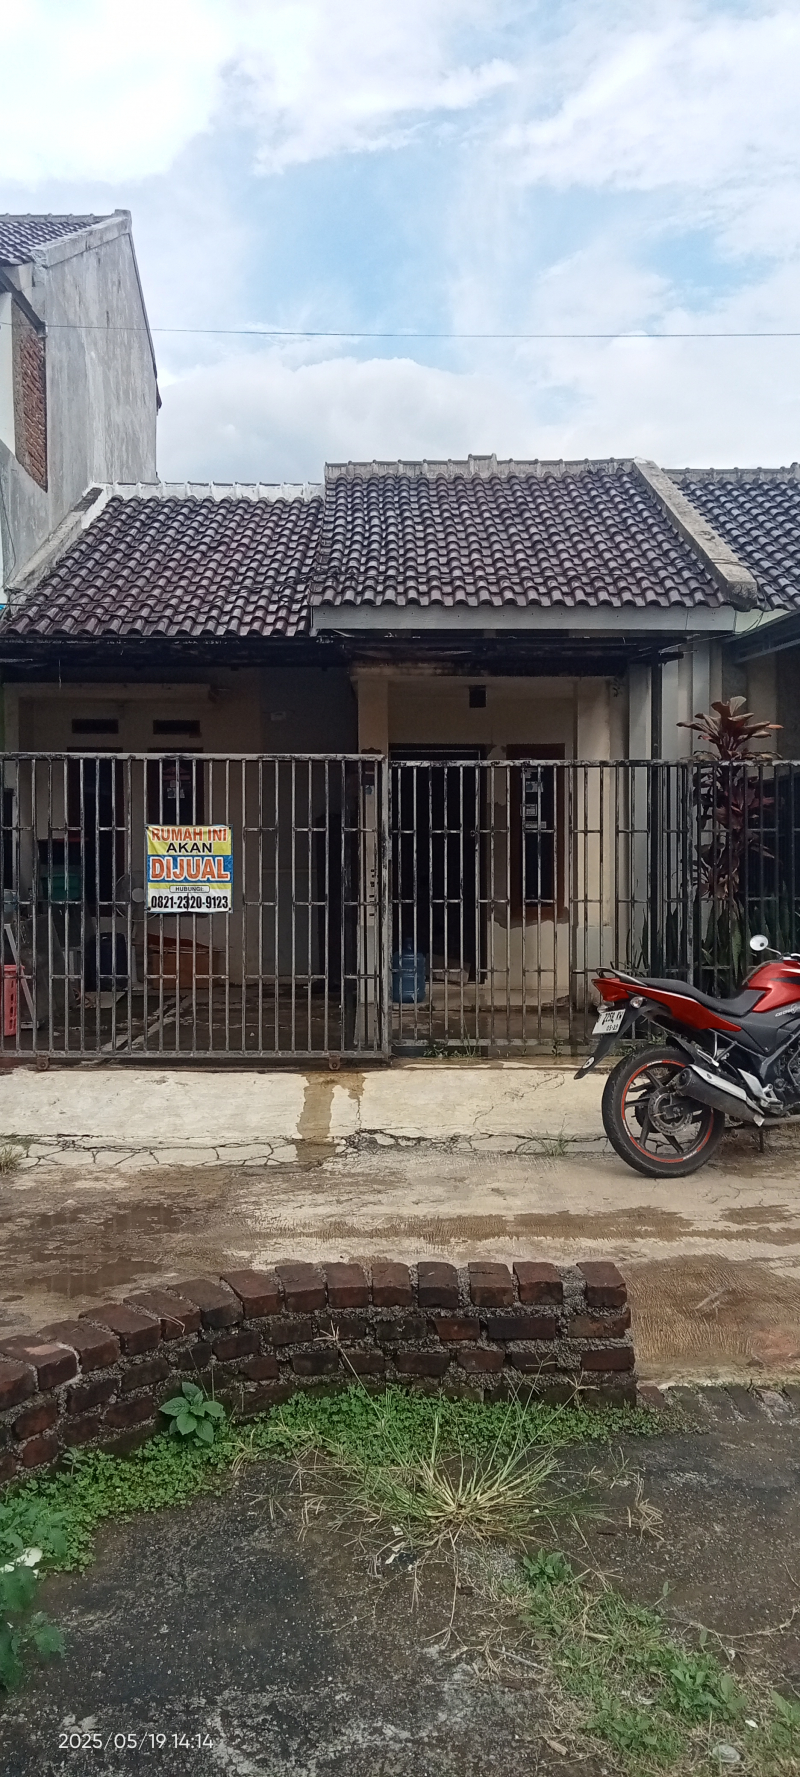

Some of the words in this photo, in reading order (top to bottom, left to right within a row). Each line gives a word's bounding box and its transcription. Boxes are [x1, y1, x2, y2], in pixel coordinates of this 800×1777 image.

[151, 827, 203, 842] RUMAH
[207, 828, 228, 842] INI
[166, 842, 213, 853] AKAN
[150, 857, 230, 880] DIJUAL
[151, 895, 229, 909] 0821-2320-9123
